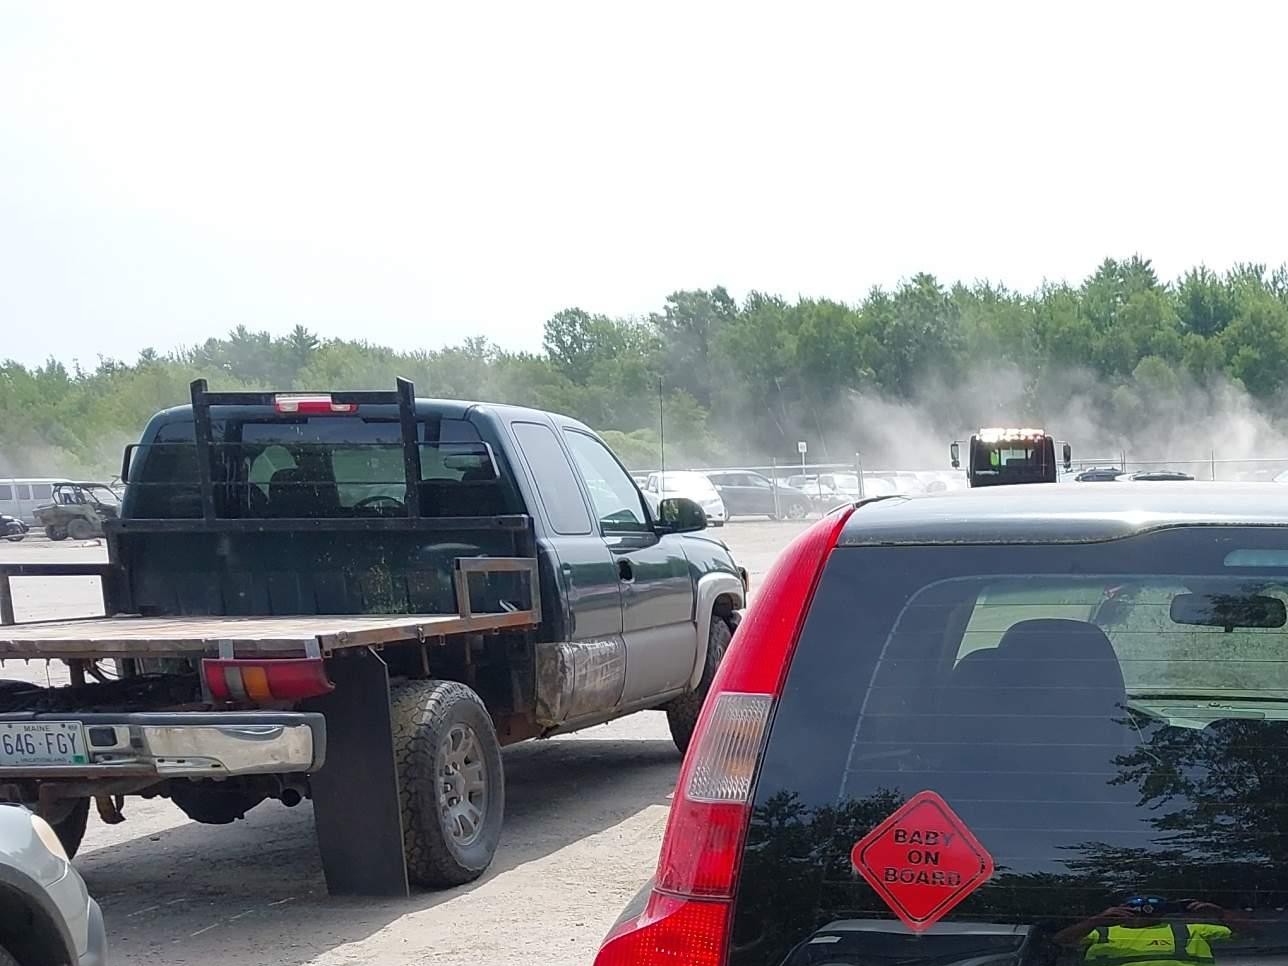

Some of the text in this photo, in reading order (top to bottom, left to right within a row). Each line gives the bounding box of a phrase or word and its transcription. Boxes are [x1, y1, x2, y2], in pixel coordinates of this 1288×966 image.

[894, 829, 954, 846] BABY
[908, 850, 940, 866] ON
[884, 867, 962, 887] BOARD
